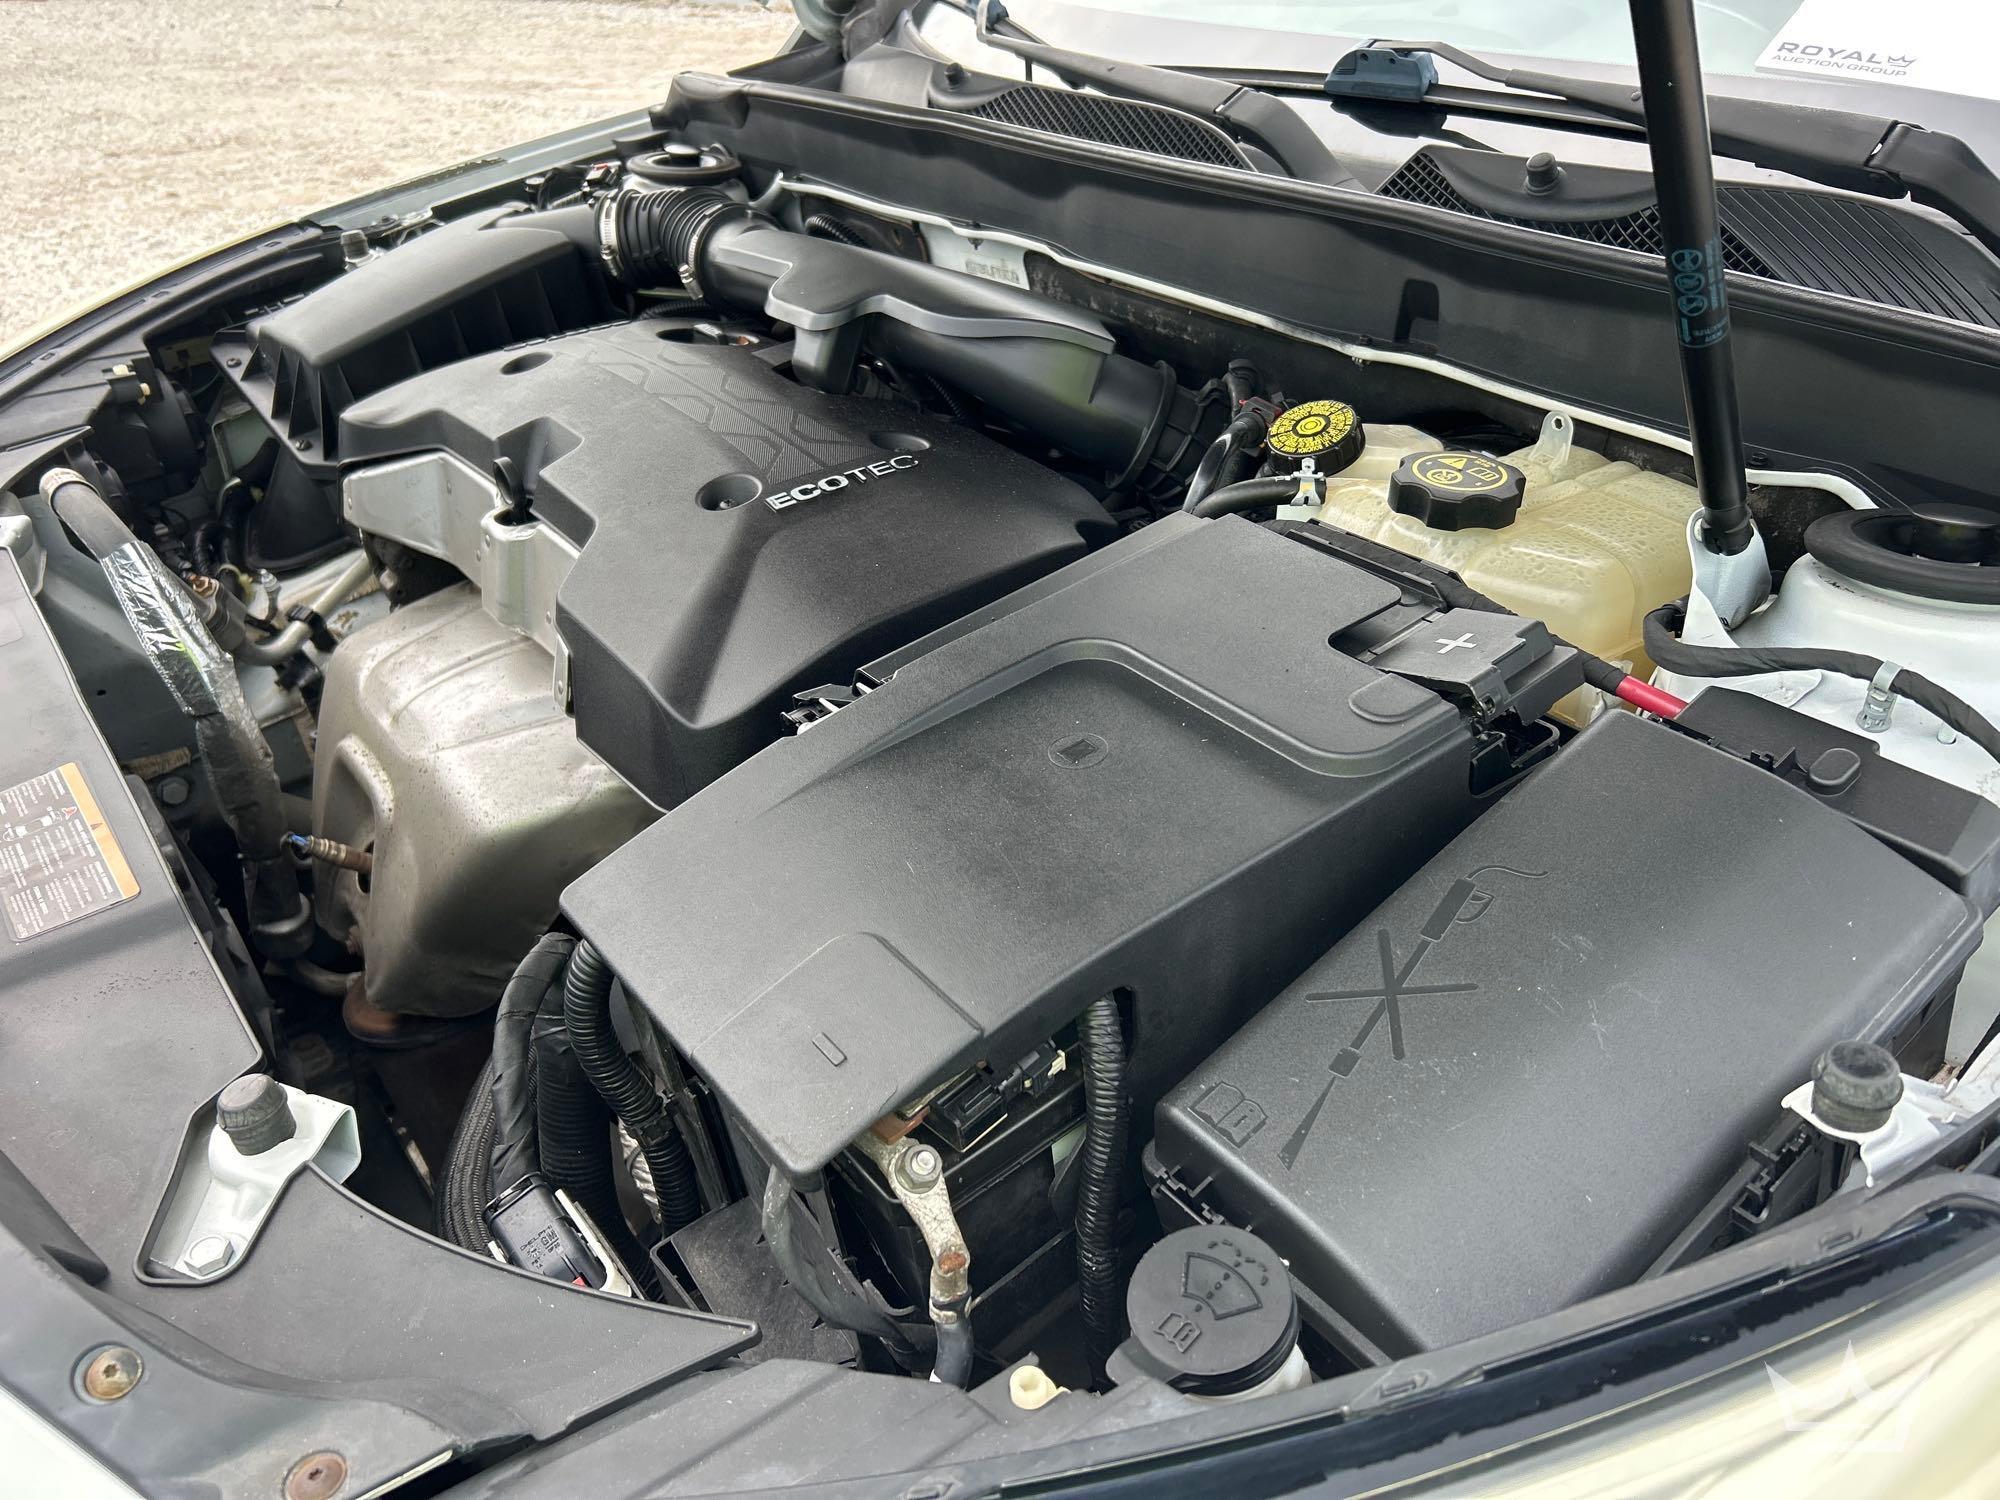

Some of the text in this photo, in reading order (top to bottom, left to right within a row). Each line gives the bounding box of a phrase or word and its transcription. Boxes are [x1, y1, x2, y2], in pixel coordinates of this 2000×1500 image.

[1777, 42, 1882, 64] ROYAL
[1772, 54, 1908, 77] AUCTION GROUP
[765, 454, 919, 513] ECOTEC
